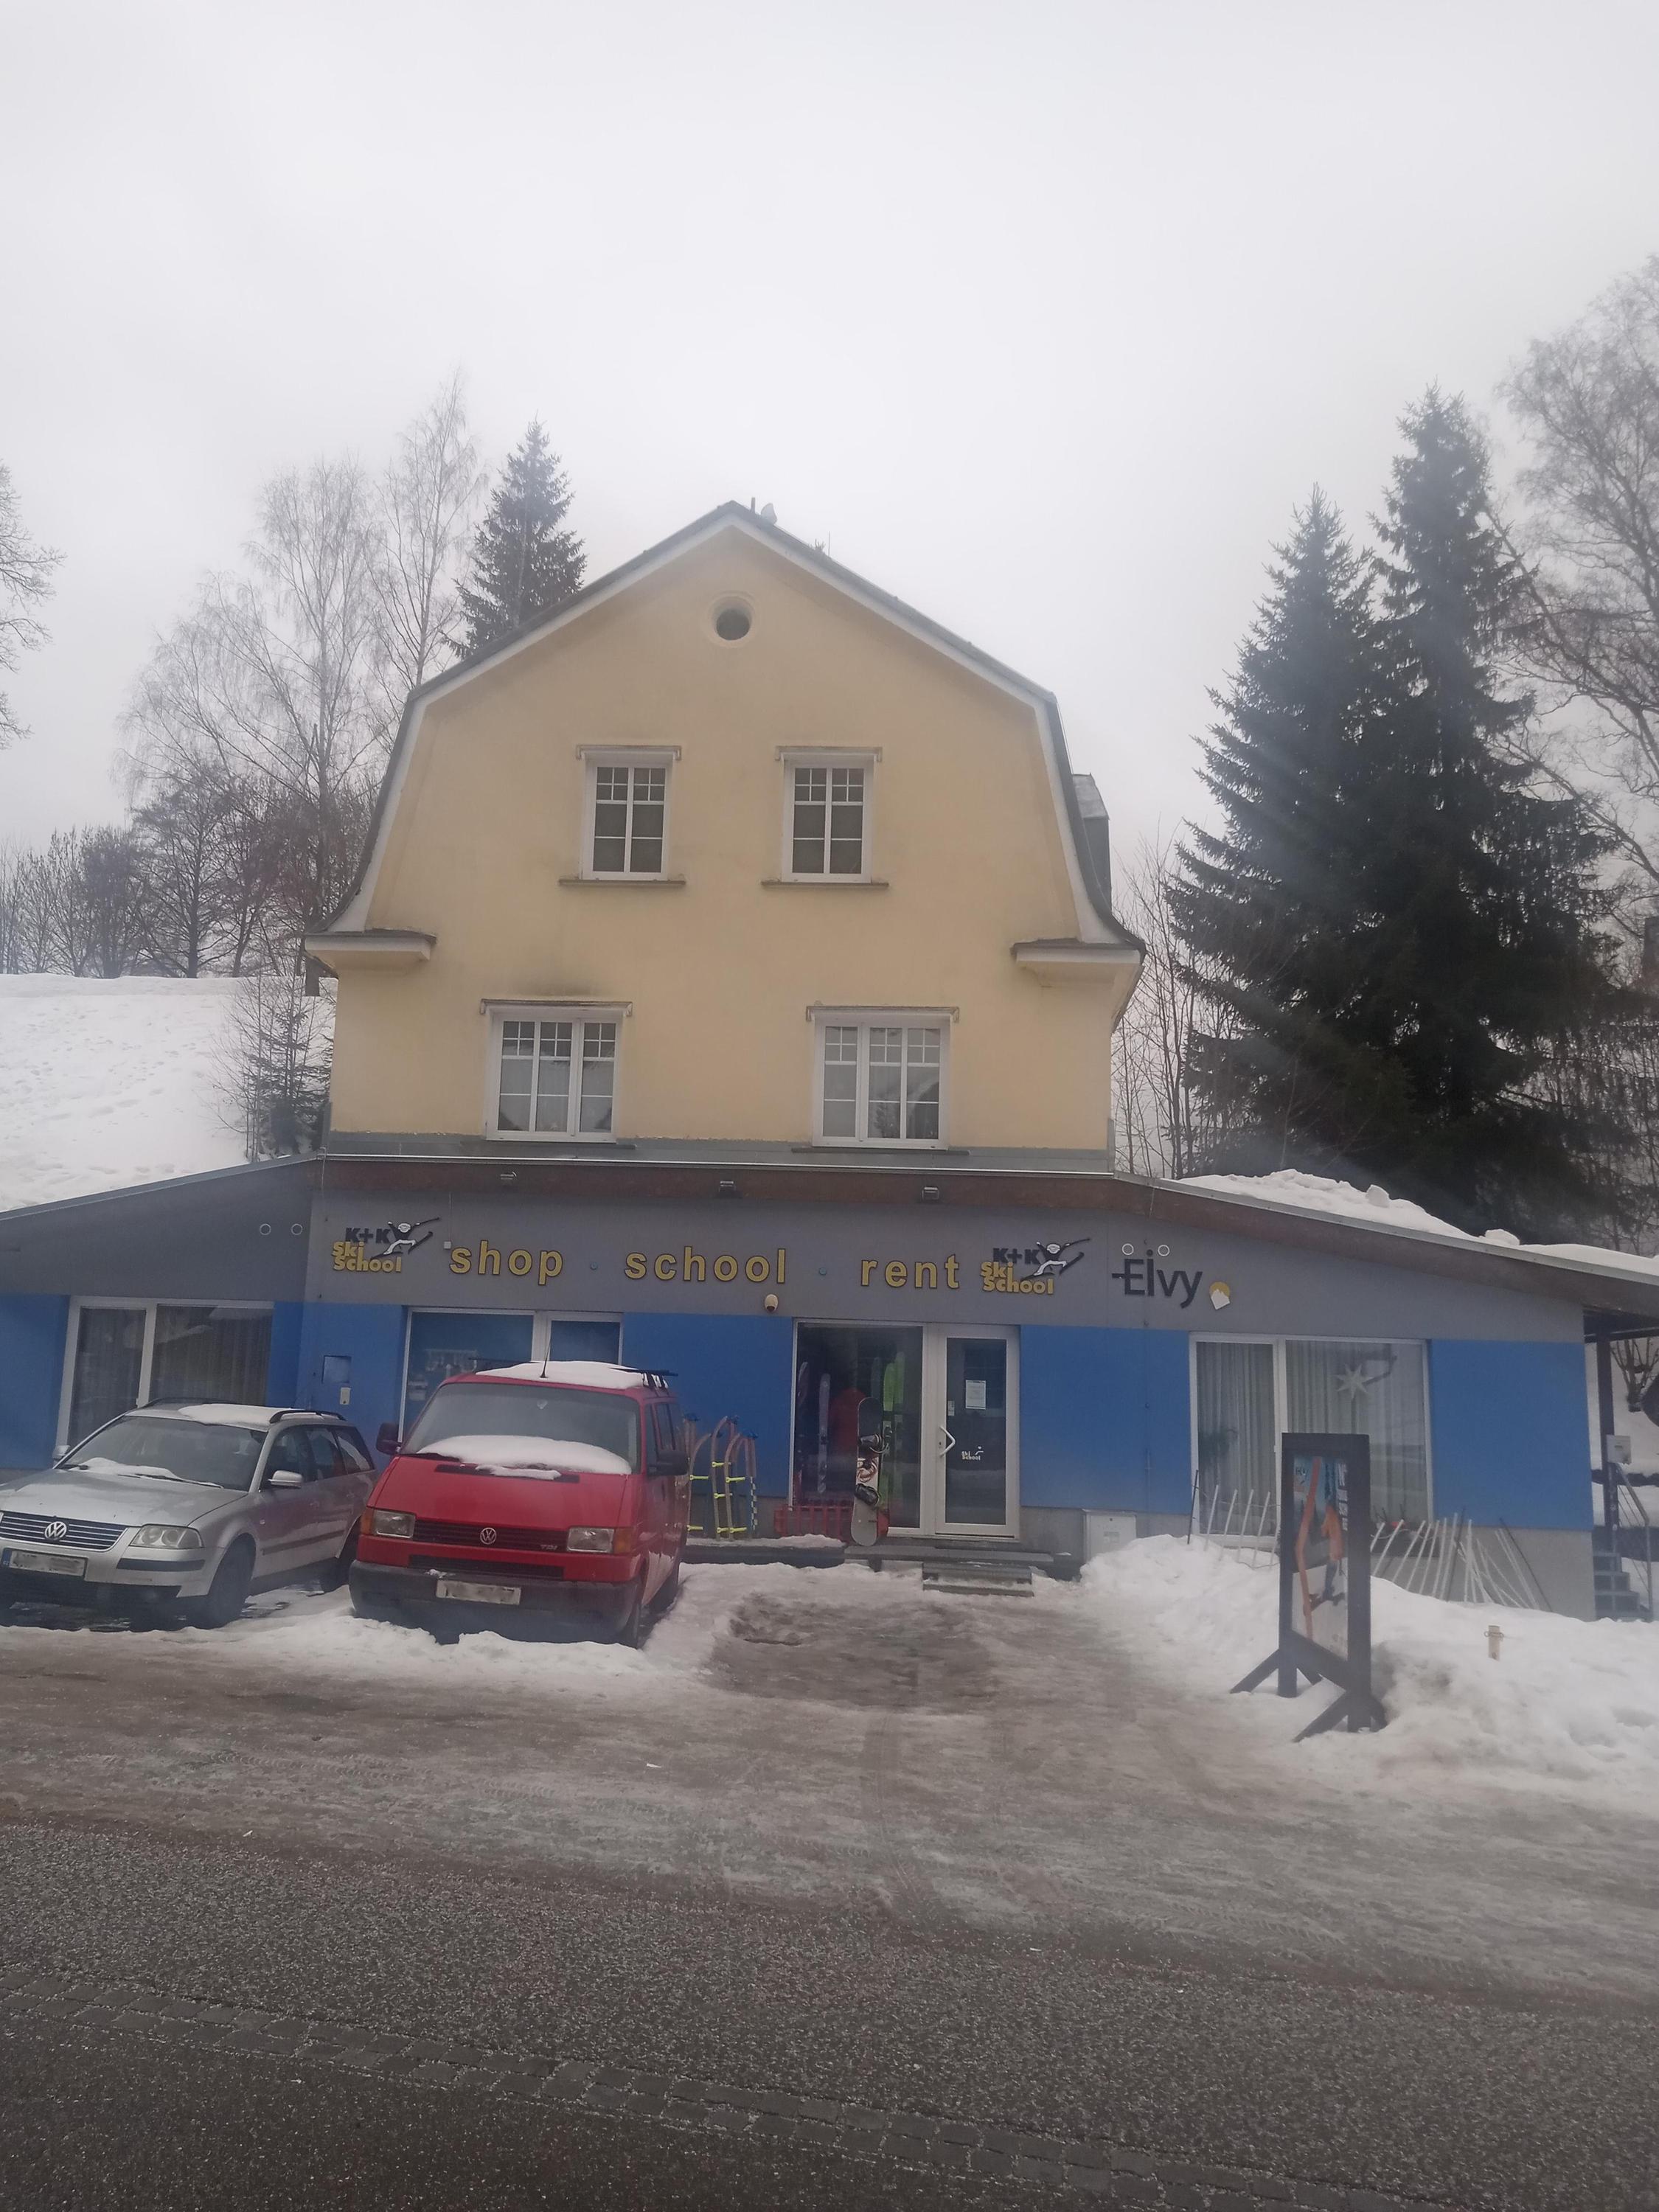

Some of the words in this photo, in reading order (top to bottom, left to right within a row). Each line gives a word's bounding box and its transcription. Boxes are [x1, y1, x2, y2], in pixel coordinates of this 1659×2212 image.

[332, 1241, 365, 1257] Ski
[333, 1254, 402, 1273] School
[449, 1240, 563, 1285] shop
[625, 1246, 786, 1284] school
[860, 1254, 960, 1290] rent
[980, 1262, 1015, 1278] Ski
[983, 1276, 1055, 1295] School
